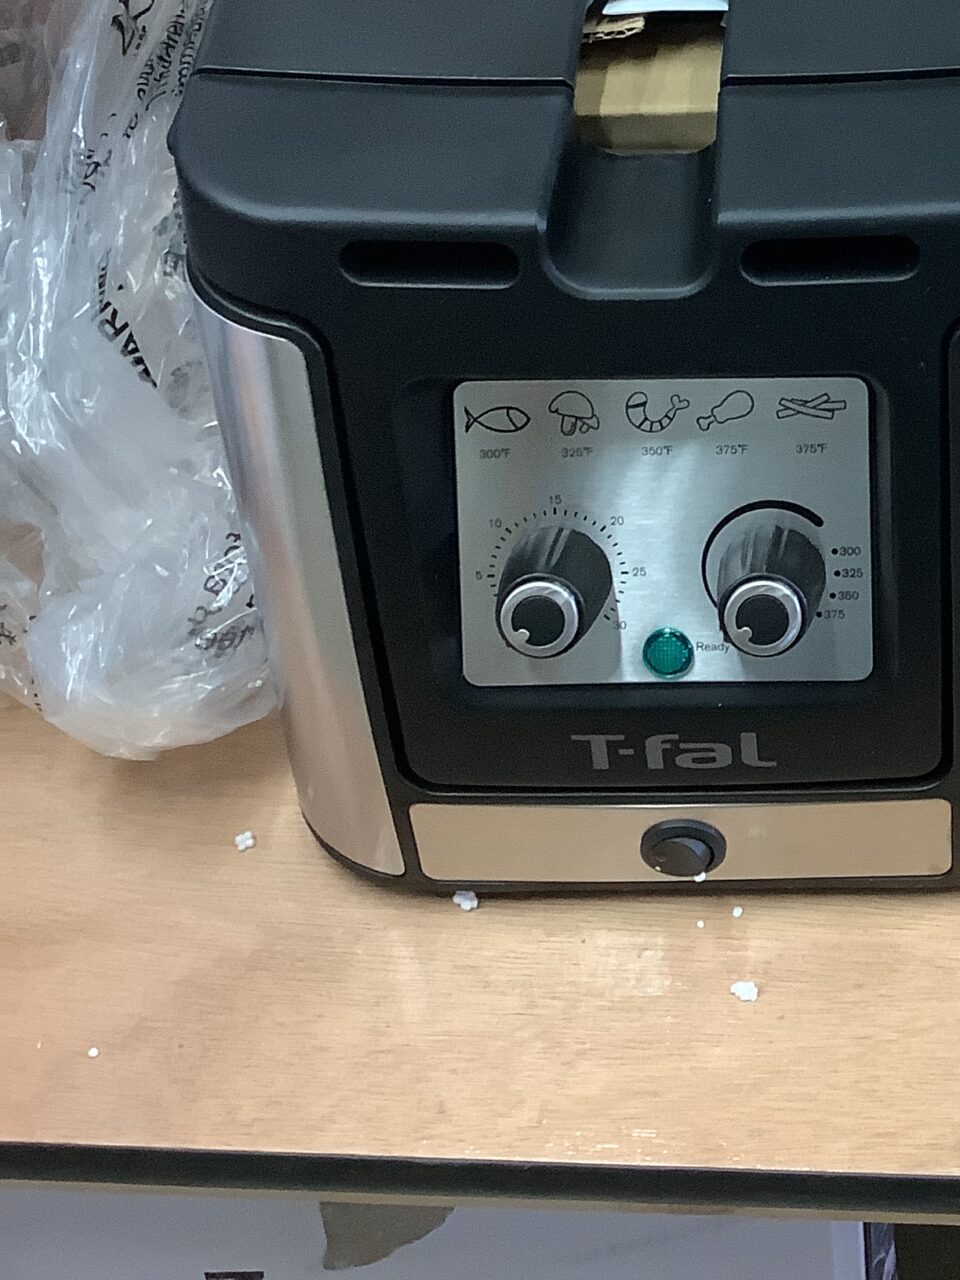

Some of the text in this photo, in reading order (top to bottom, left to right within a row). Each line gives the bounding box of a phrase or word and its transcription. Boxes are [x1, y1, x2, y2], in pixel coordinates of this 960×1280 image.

[641, 445, 673, 455] 350°F
[715, 443, 748, 455] 375°F
[796, 443, 828, 454] 375°F
[549, 494, 562, 504] 15
[489, 518, 502, 528] 10
[610, 516, 625, 526] 20
[839, 546, 861, 556] 300
[476, 571, 483, 580] 5
[632, 567, 647, 577] 25
[841, 568, 864, 578] 325
[838, 591, 859, 600] 350
[823, 609, 845, 619] 375
[613, 621, 627, 630] 30
[696, 642, 730, 653] Ready
[571, 732, 777, 770] T-fal
